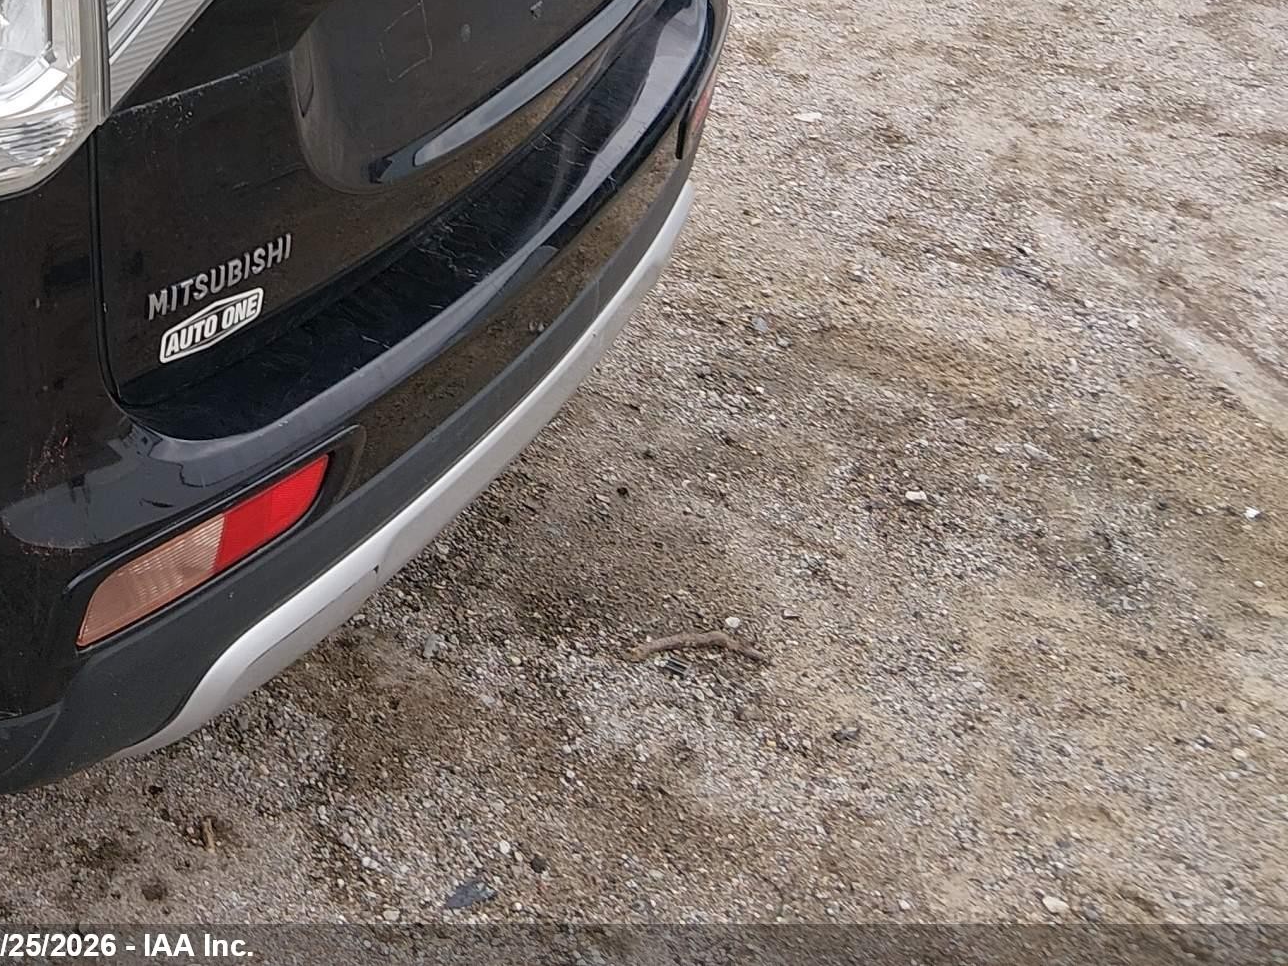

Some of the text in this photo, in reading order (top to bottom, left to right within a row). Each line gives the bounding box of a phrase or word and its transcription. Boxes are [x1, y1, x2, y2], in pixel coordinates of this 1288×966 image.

[148, 233, 292, 321] MITSUBISHI
[165, 294, 258, 357] AUTO ONE
